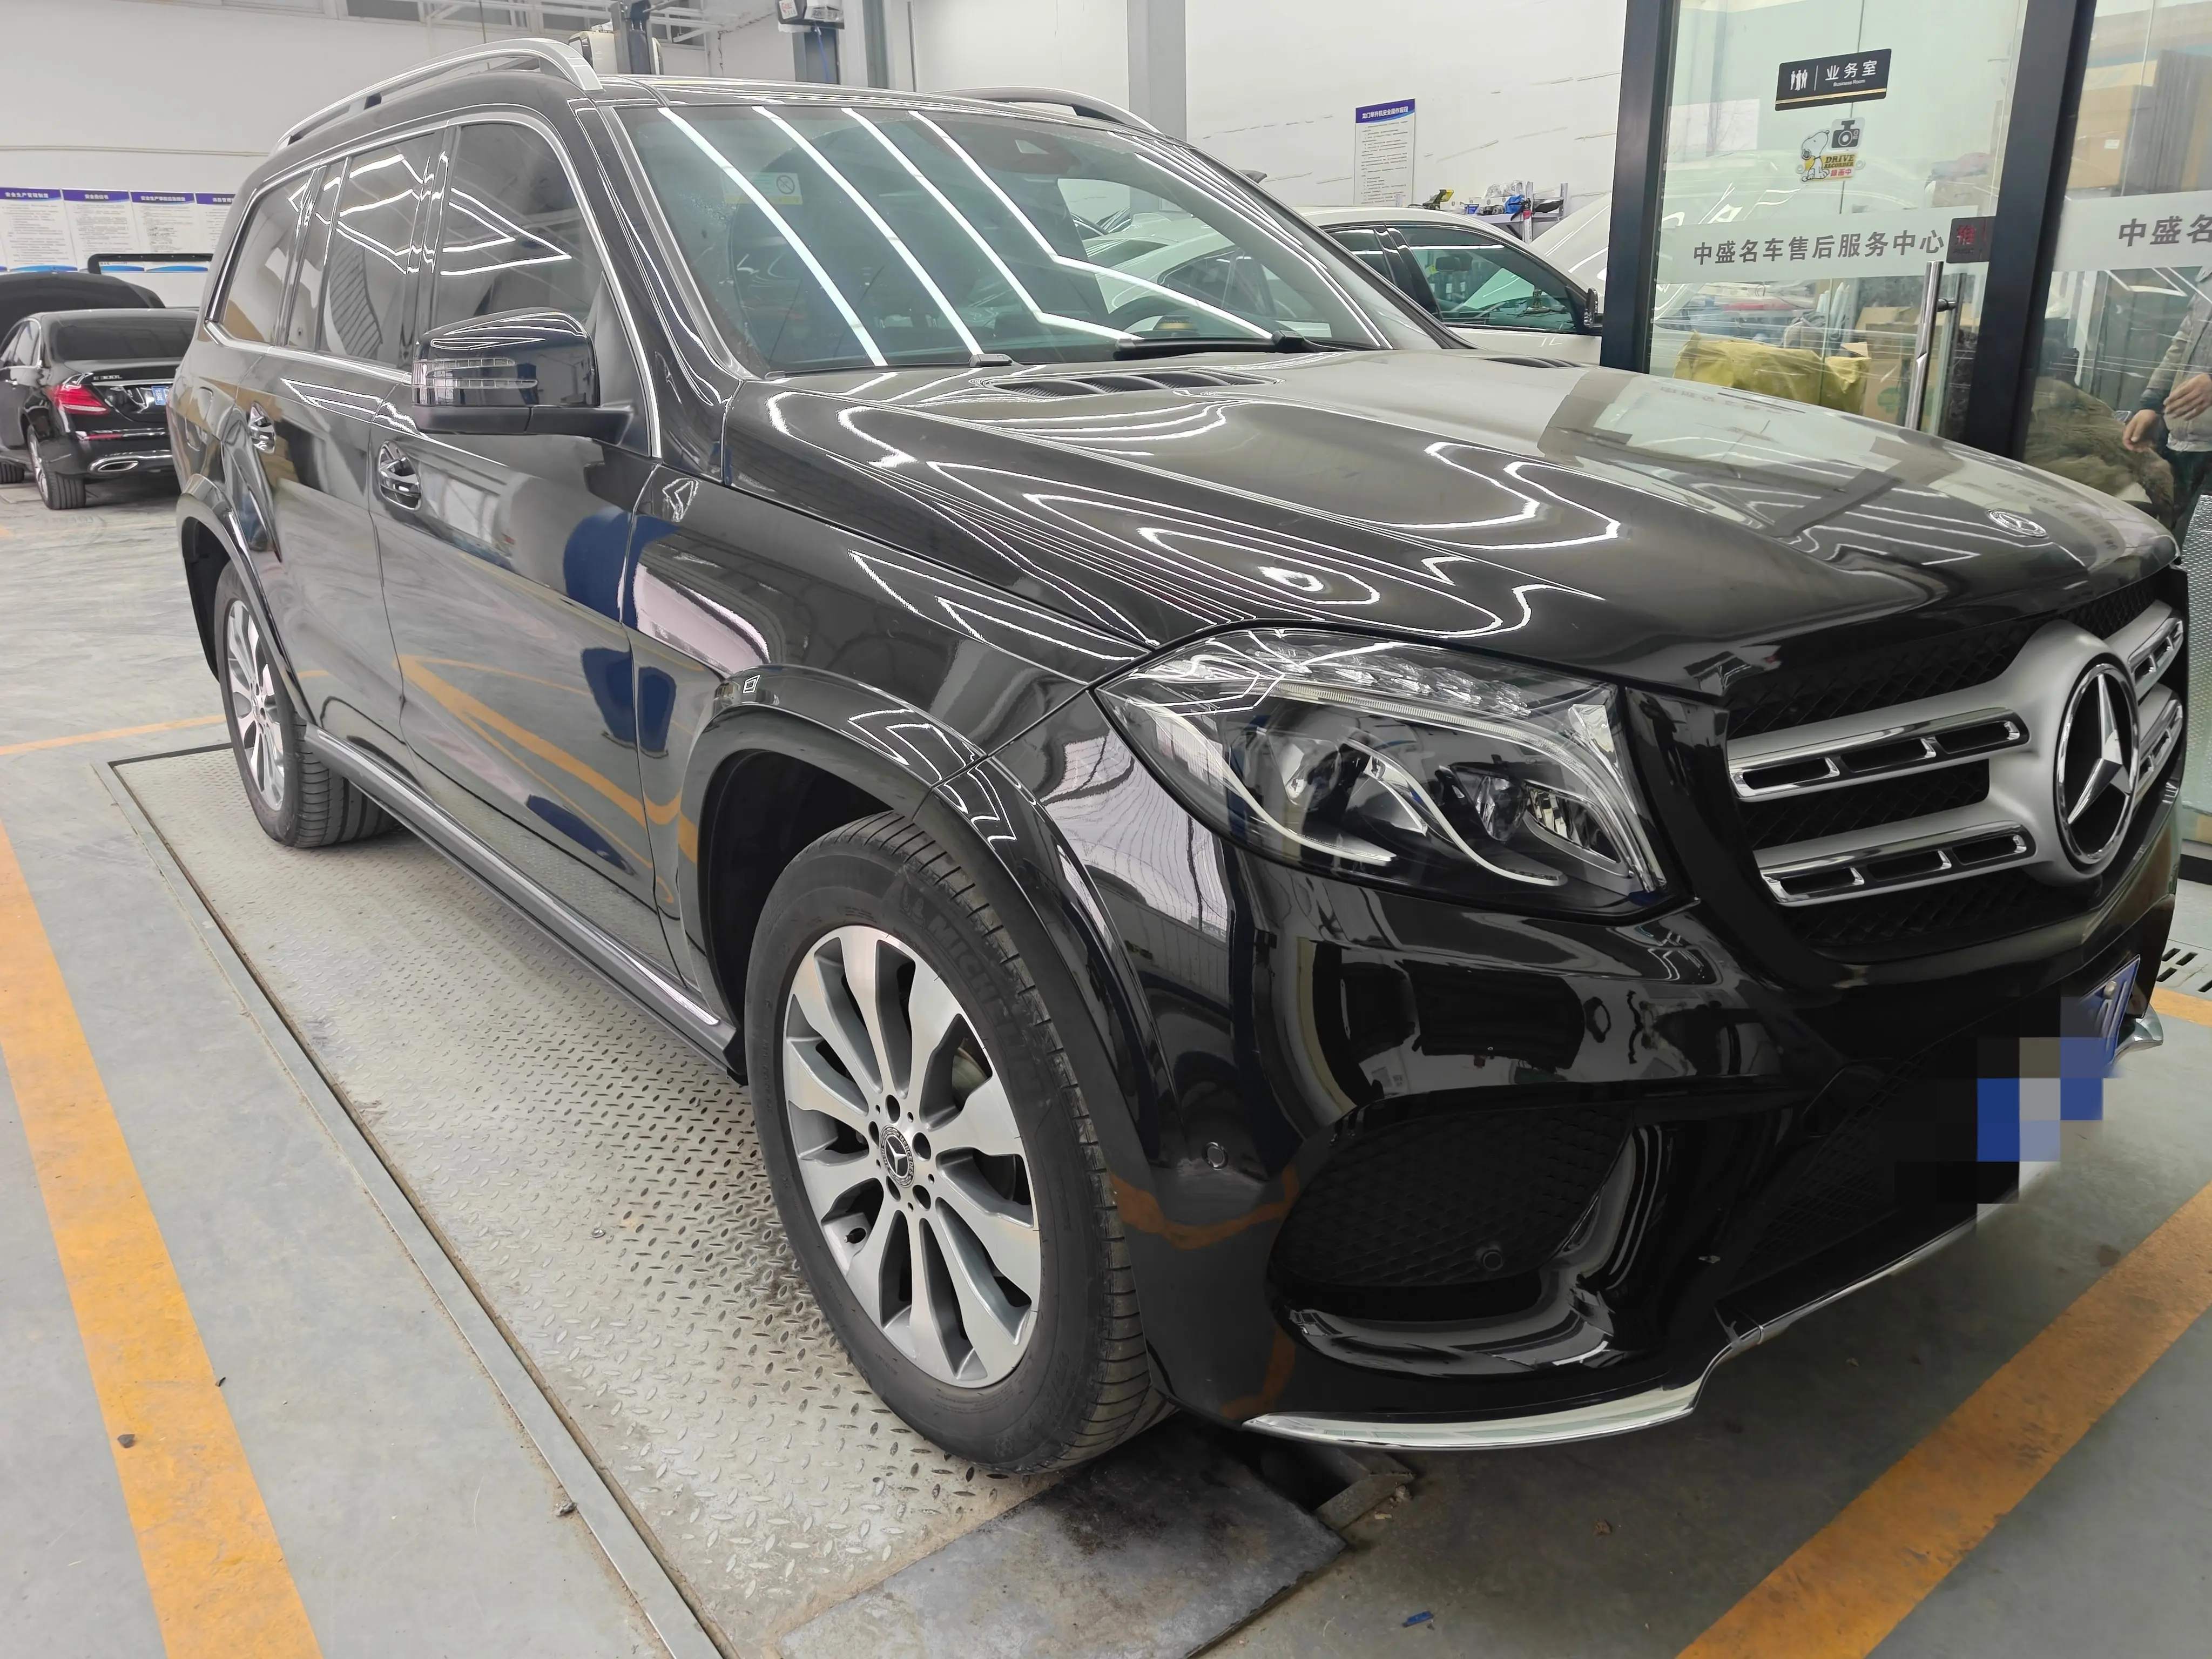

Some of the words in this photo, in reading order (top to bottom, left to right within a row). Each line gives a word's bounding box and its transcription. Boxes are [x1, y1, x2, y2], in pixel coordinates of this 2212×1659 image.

[1825, 60, 1877, 80] 业务室
[2119, 214, 2212, 247] 中盛名
[1694, 230, 1944, 265] 中盛名车售后服务中心
